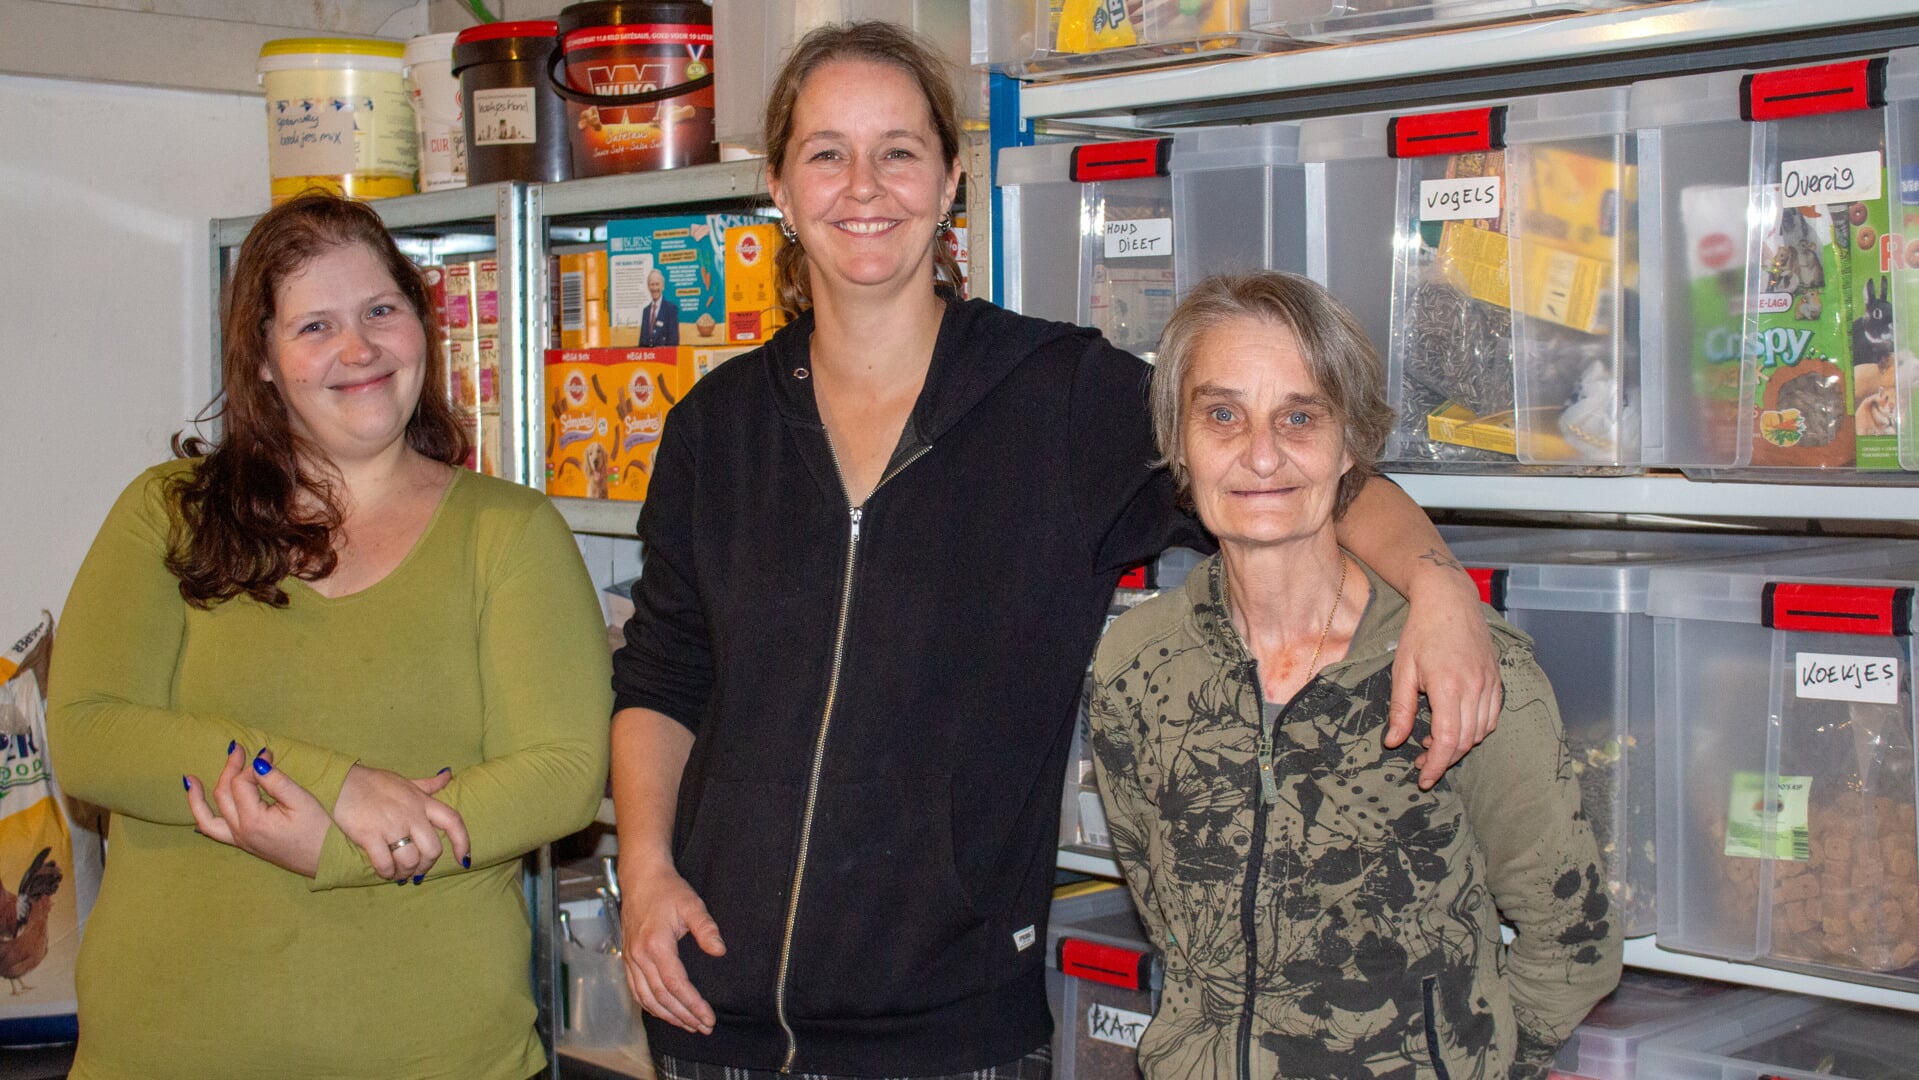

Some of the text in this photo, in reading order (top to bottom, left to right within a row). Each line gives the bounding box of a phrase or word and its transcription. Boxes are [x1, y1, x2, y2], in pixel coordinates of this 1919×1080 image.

[320, 131, 341, 145] mix
[1106, 223, 1138, 235] HOND
[1704, 327, 1815, 367] Crspy
